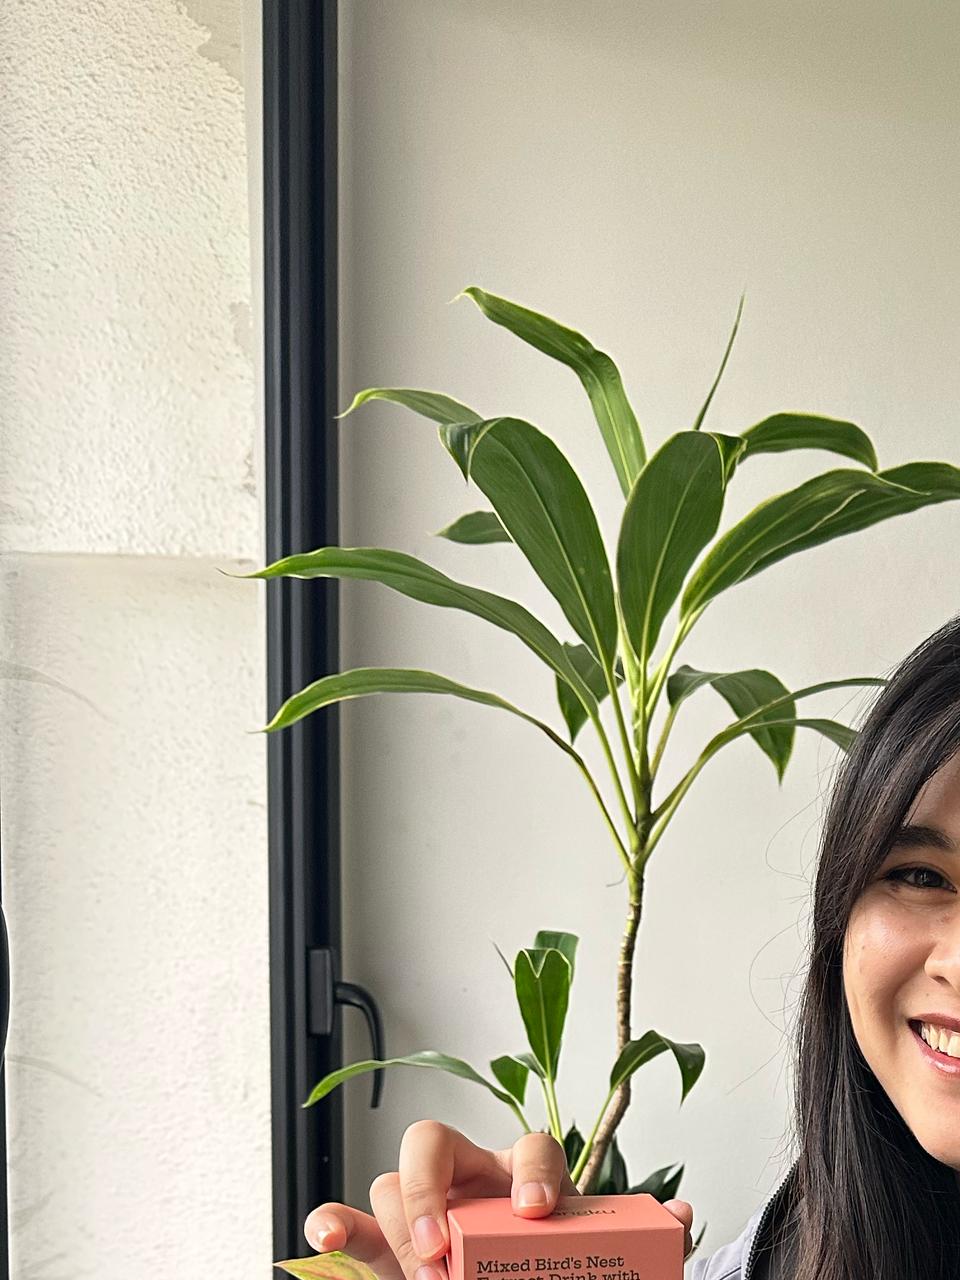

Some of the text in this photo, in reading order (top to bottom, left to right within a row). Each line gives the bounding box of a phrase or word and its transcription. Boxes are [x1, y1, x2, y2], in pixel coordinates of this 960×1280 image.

[477, 1256, 625, 1273] Mixed Bird's Nest
